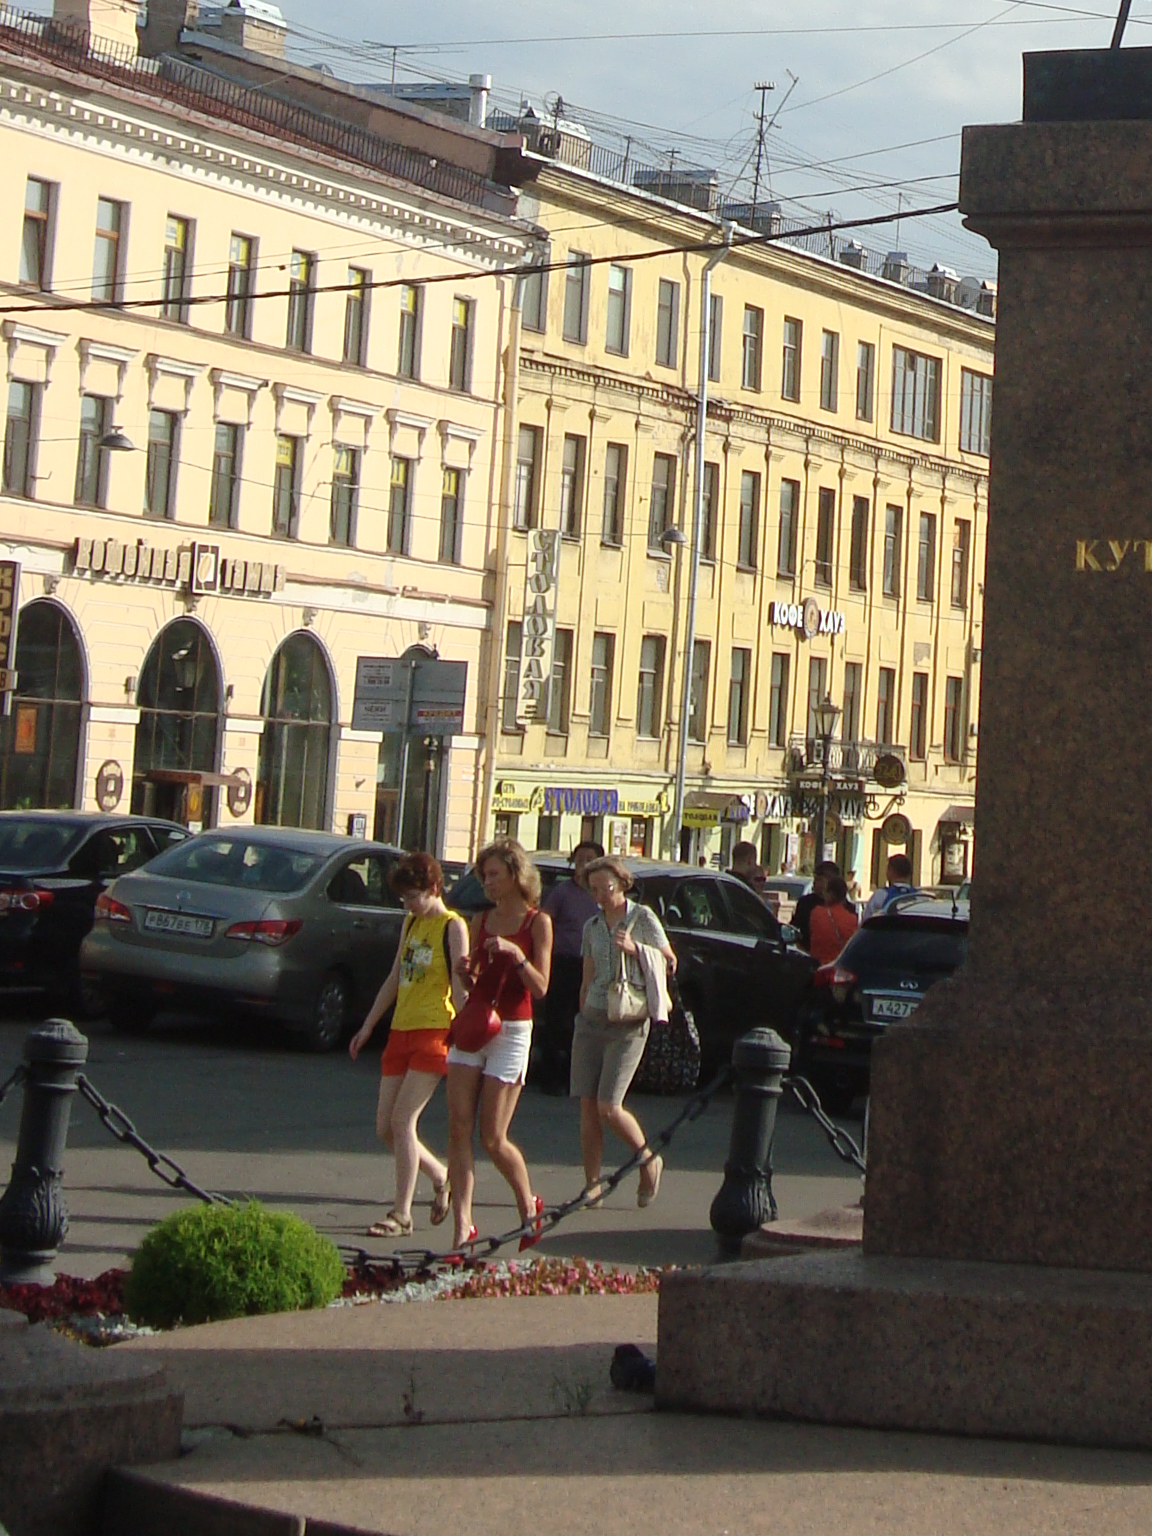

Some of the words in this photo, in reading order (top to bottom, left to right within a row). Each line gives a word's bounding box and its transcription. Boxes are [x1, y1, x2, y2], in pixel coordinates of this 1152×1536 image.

[521, 529, 551, 701] СТОЛОВАЯ
[773, 600, 804, 628] КОФЕ
[819, 609, 846, 635] ХАУЗ
[544, 787, 618, 814] СТОЛОВАЯ
